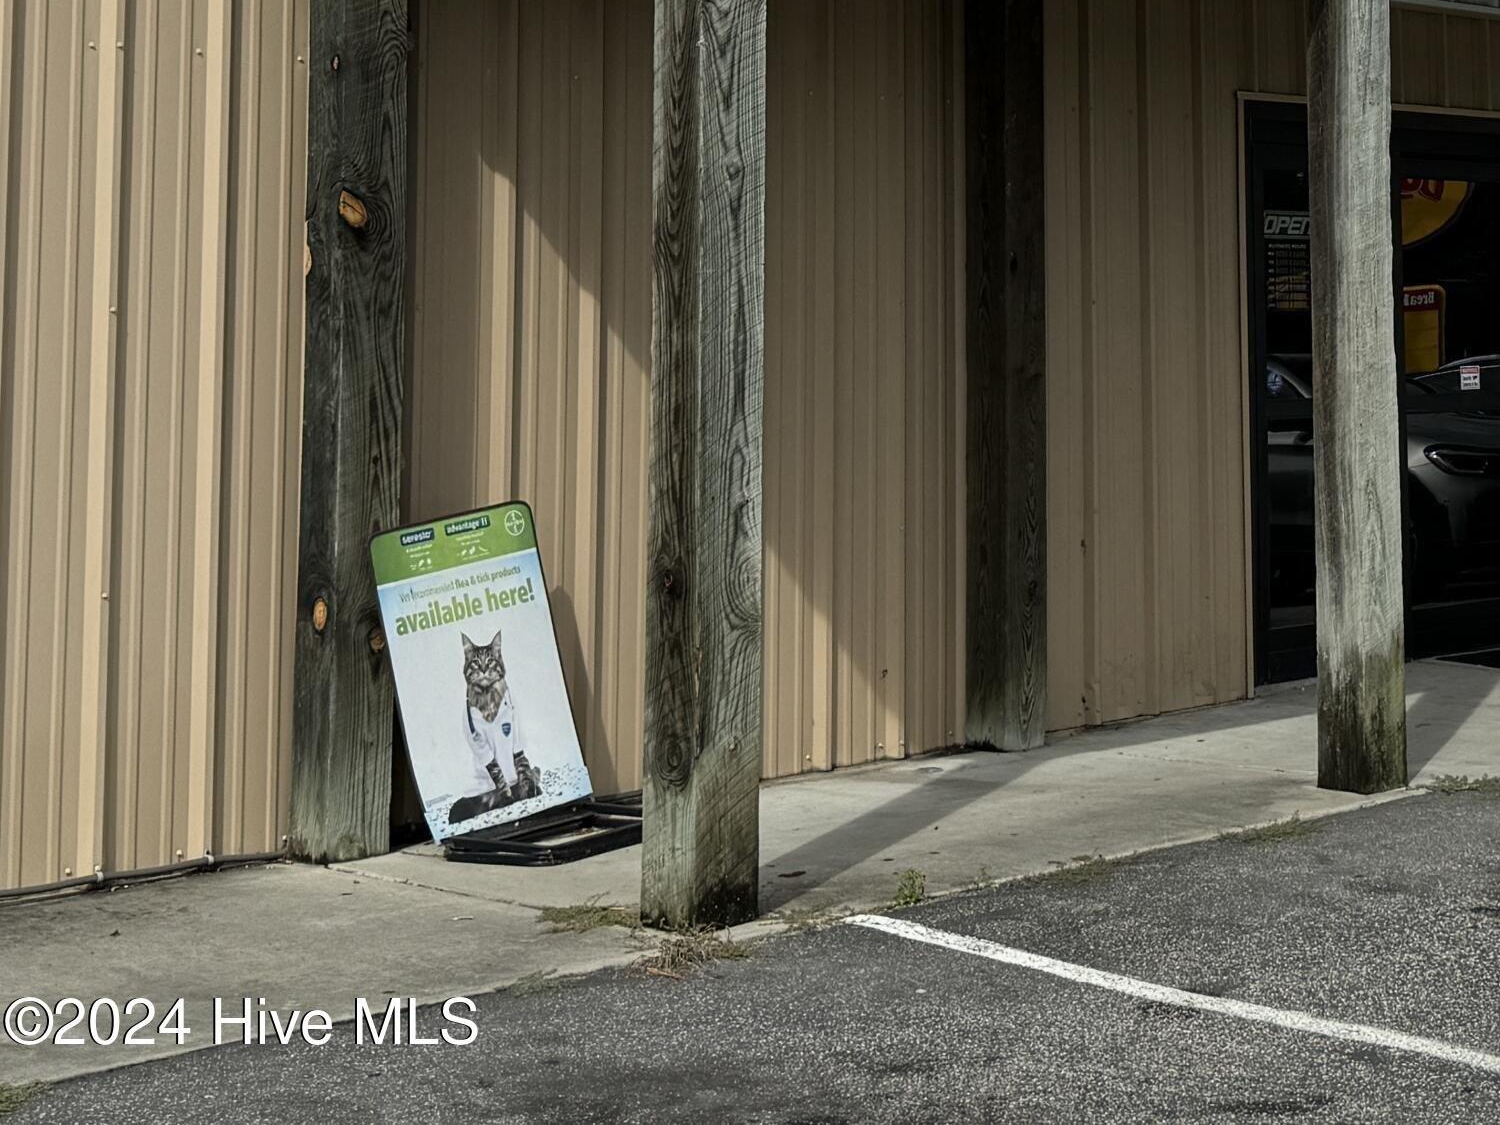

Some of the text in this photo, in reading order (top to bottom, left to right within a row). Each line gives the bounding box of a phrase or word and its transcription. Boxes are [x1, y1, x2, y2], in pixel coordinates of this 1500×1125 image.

[490, 566, 521, 582] products
[395, 577, 535, 636] available here!
